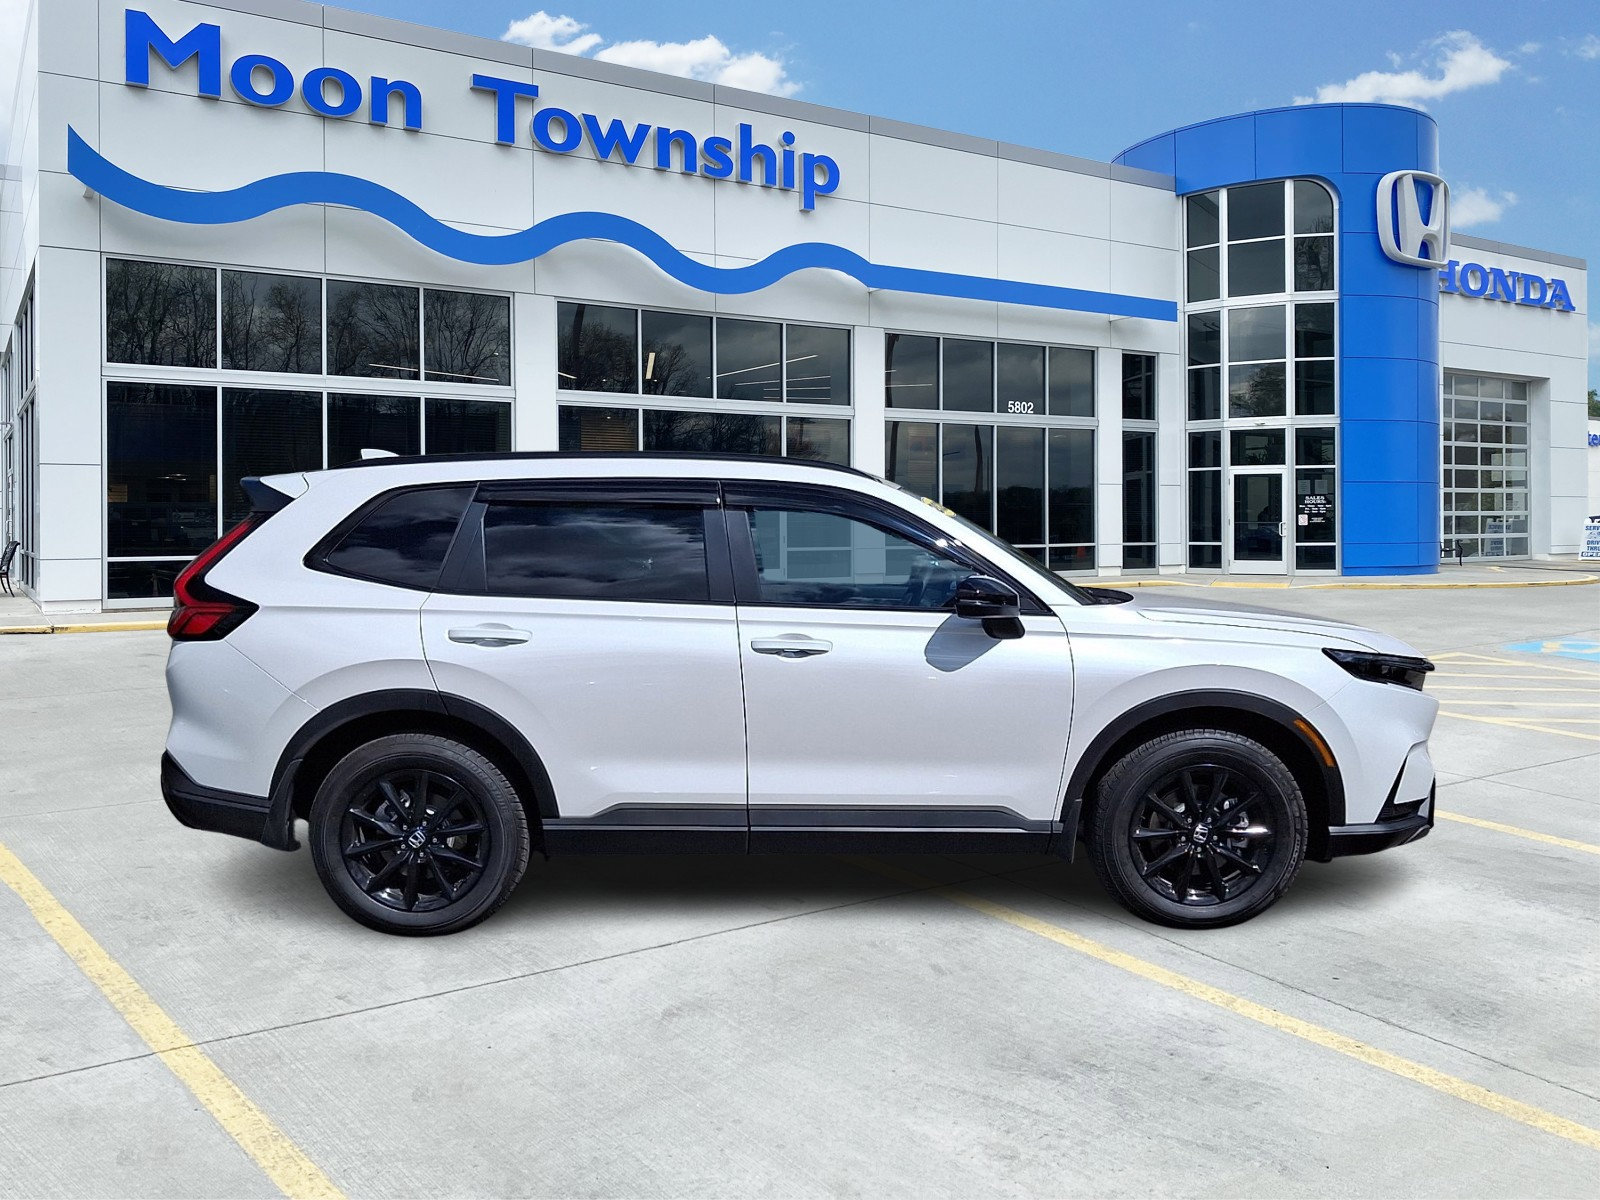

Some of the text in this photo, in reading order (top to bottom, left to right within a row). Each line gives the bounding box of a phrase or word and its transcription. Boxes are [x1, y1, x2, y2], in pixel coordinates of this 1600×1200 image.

[125, 9, 840, 212] Moon Township
[1007, 400, 1034, 414] 5802
